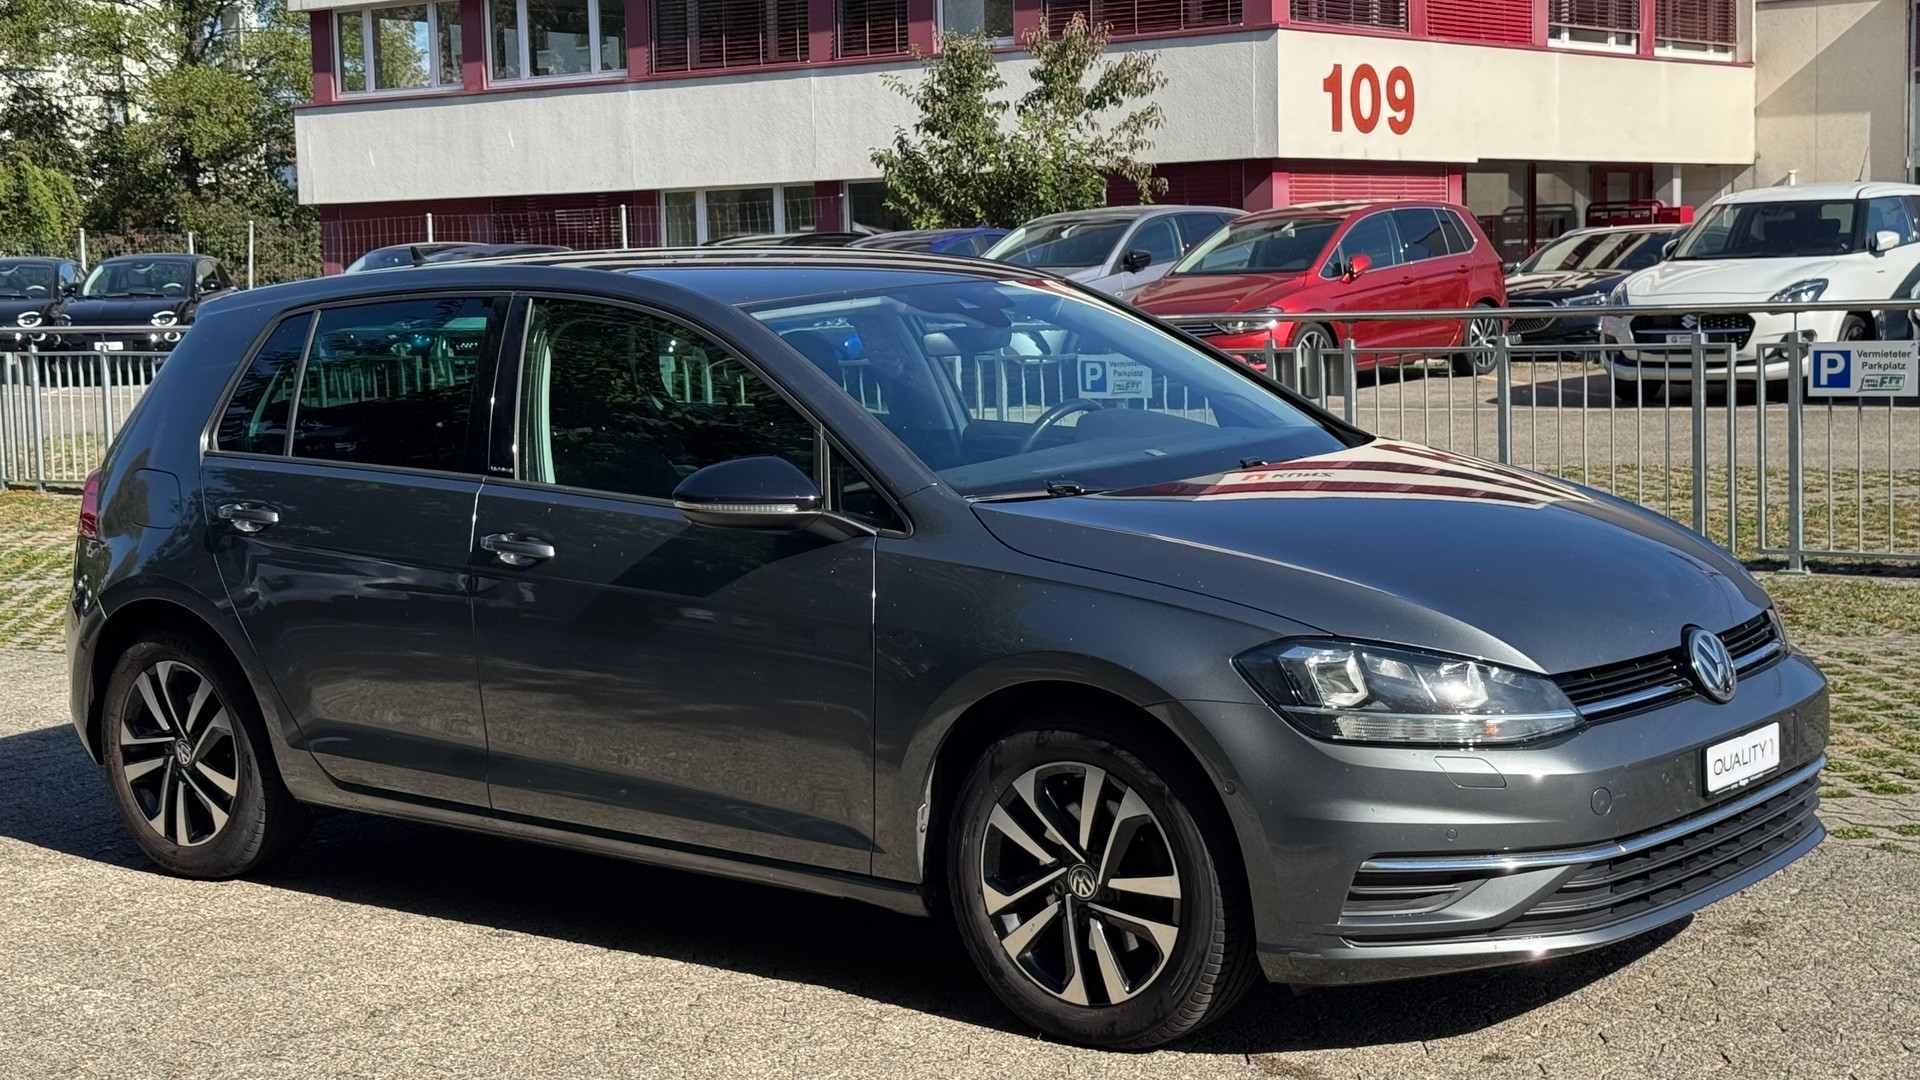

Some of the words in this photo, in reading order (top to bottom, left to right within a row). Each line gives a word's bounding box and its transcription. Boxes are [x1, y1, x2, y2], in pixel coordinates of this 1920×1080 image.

[1323, 63, 1415, 135] 109
[1819, 352, 1846, 386] P
[1856, 350, 1912, 358] Vermieteter
[1861, 362, 1906, 371] Parkplatz
[1085, 362, 1103, 390] P
[1713, 740, 1768, 776] QUALITY
